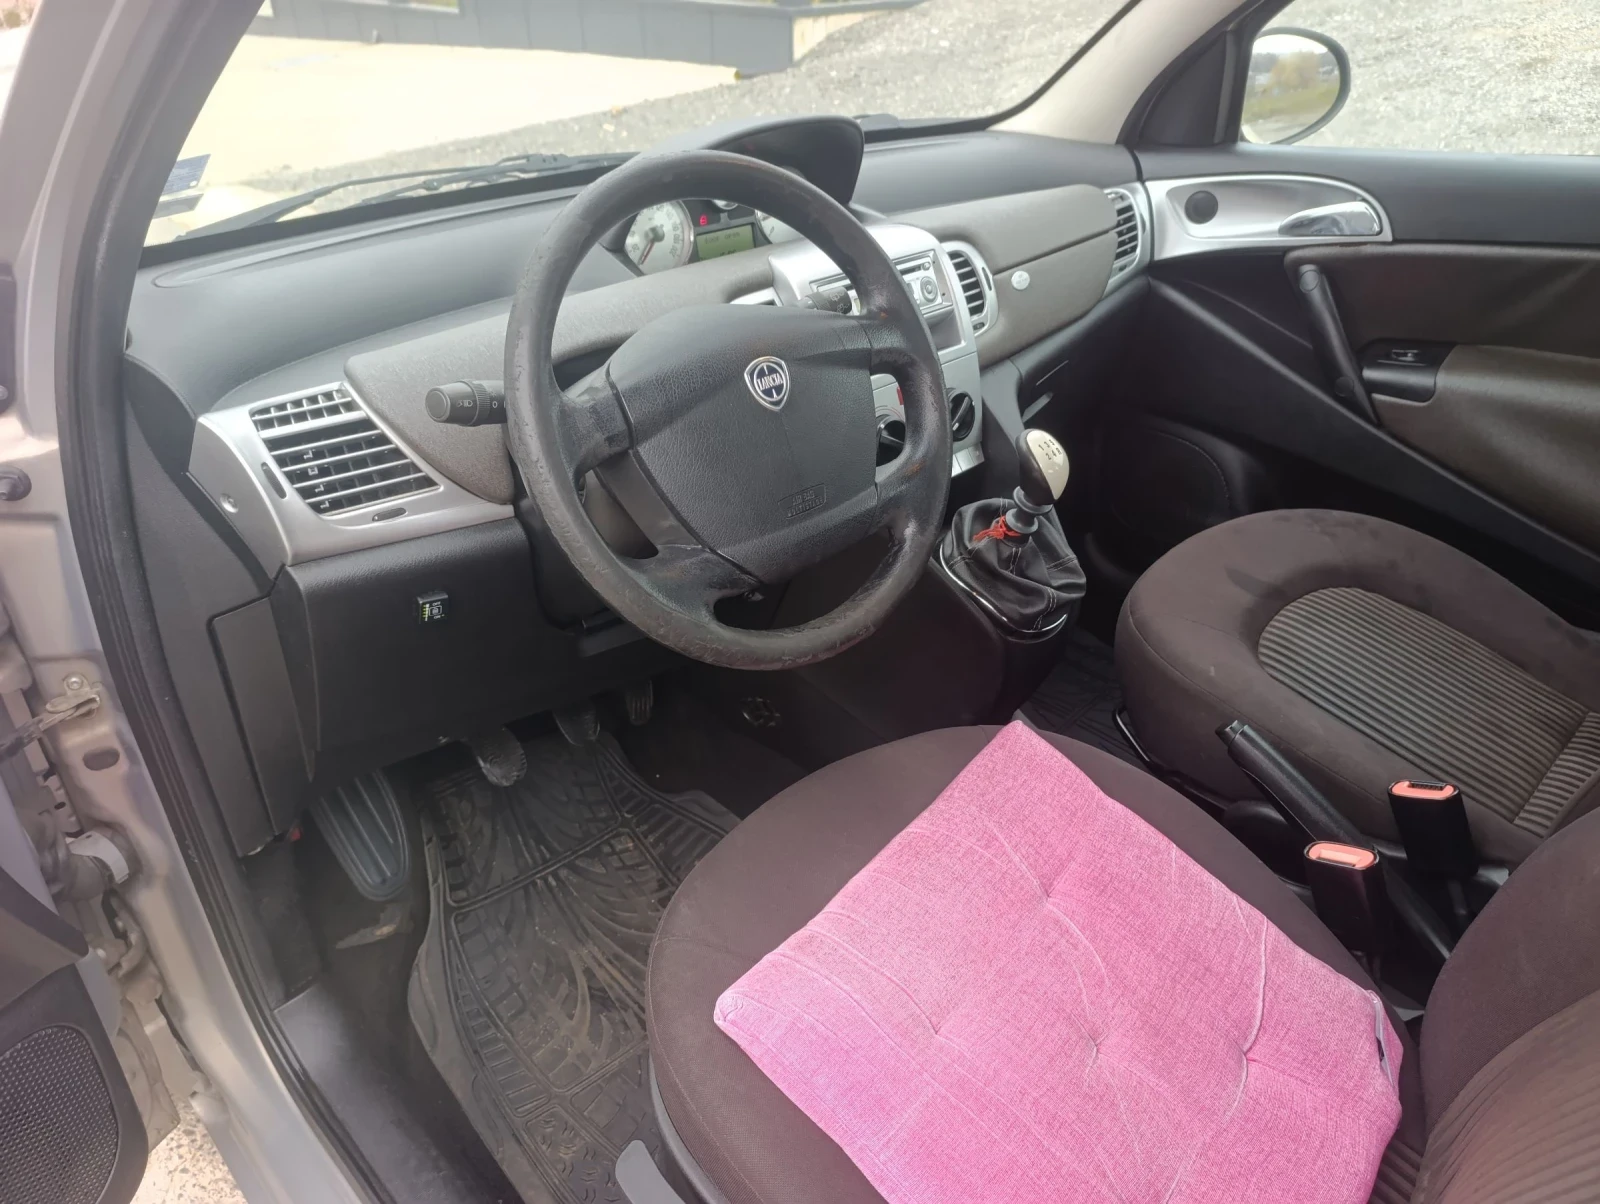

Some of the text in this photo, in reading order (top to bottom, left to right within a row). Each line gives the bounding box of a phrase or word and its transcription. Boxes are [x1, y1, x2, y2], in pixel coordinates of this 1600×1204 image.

[757, 372, 784, 391] LANCIA
[1045, 452, 1052, 460] 2
[792, 488, 816, 506] AIR BAG
